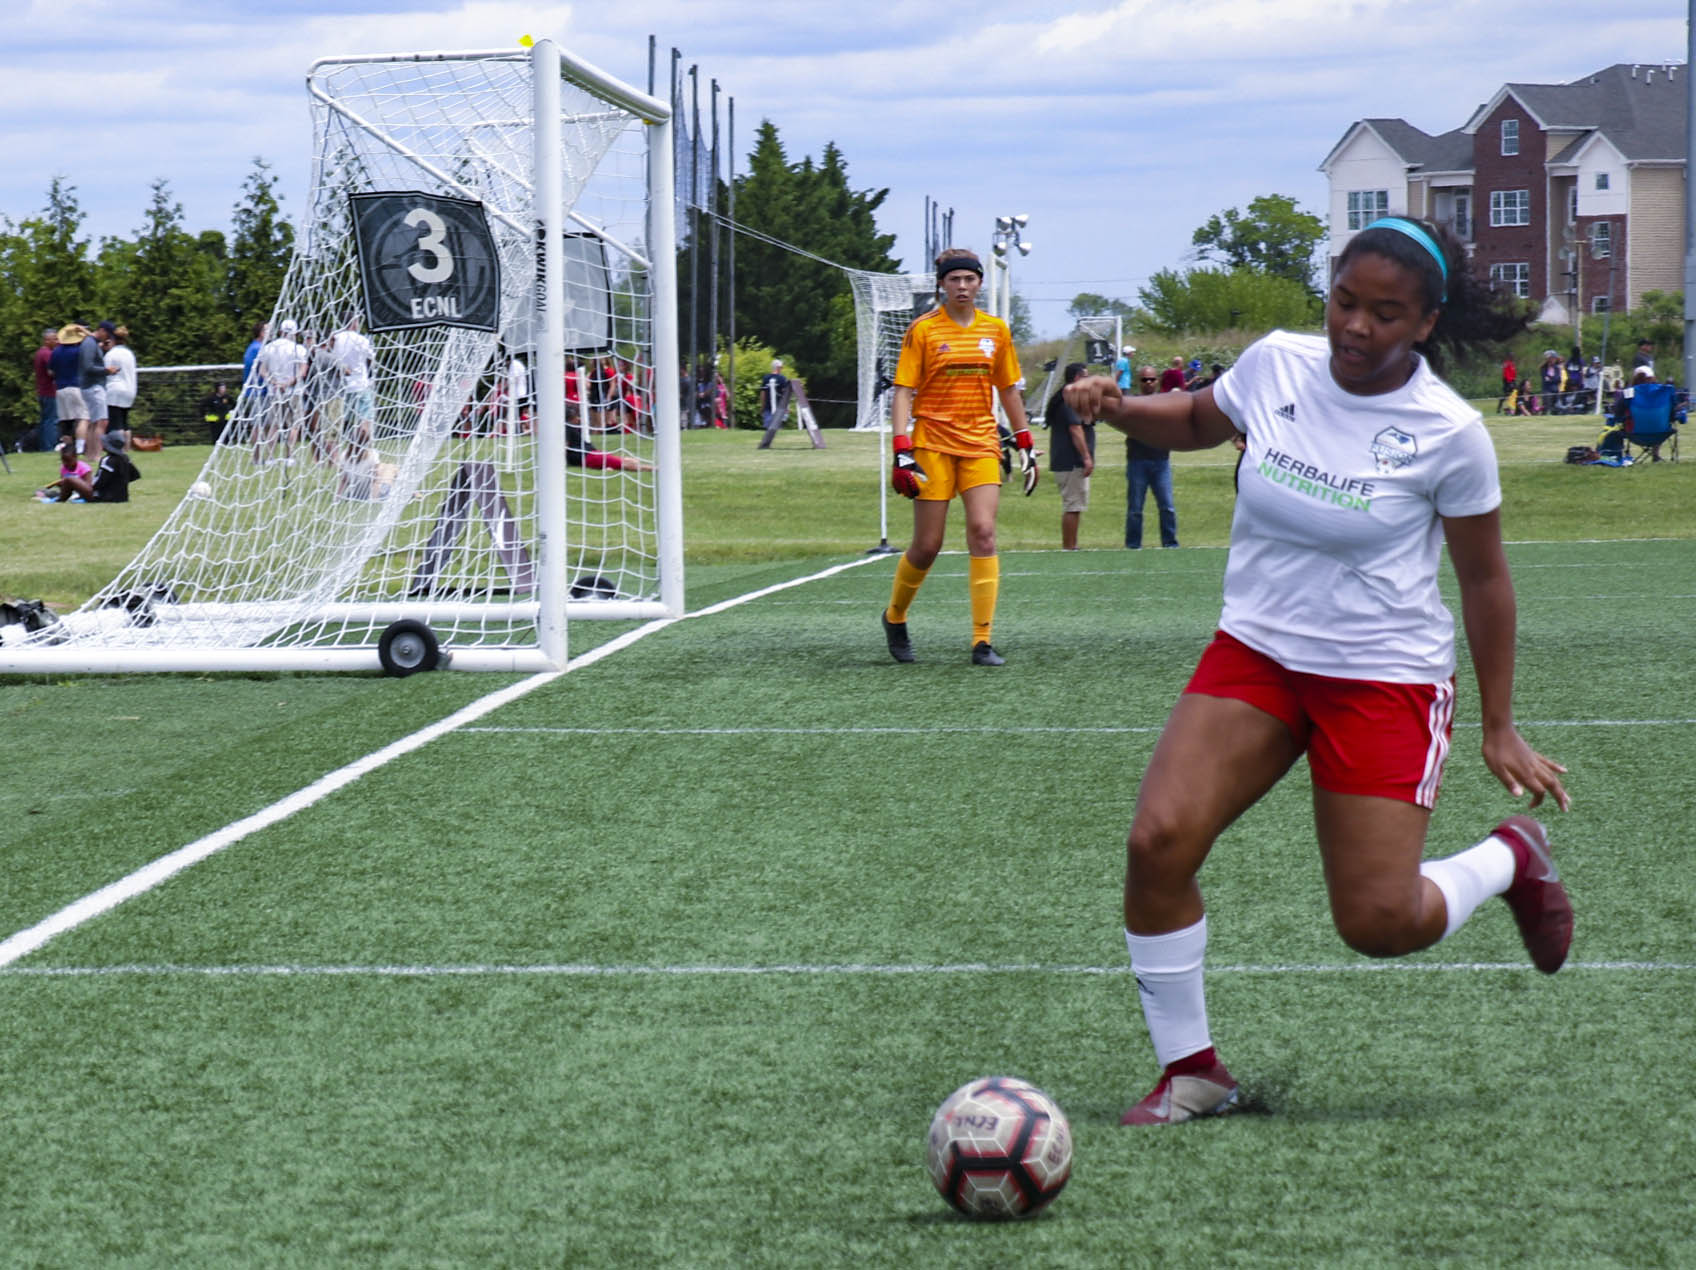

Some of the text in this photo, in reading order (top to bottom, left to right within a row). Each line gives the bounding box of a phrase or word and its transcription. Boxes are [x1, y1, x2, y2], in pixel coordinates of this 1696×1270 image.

[404, 208, 454, 283] 3
[411, 298, 463, 319] ECNL
[1094, 343, 1103, 356] 1
[1257, 461, 1372, 512] NUTRITION
[1264, 448, 1375, 497] HERBALIFE
